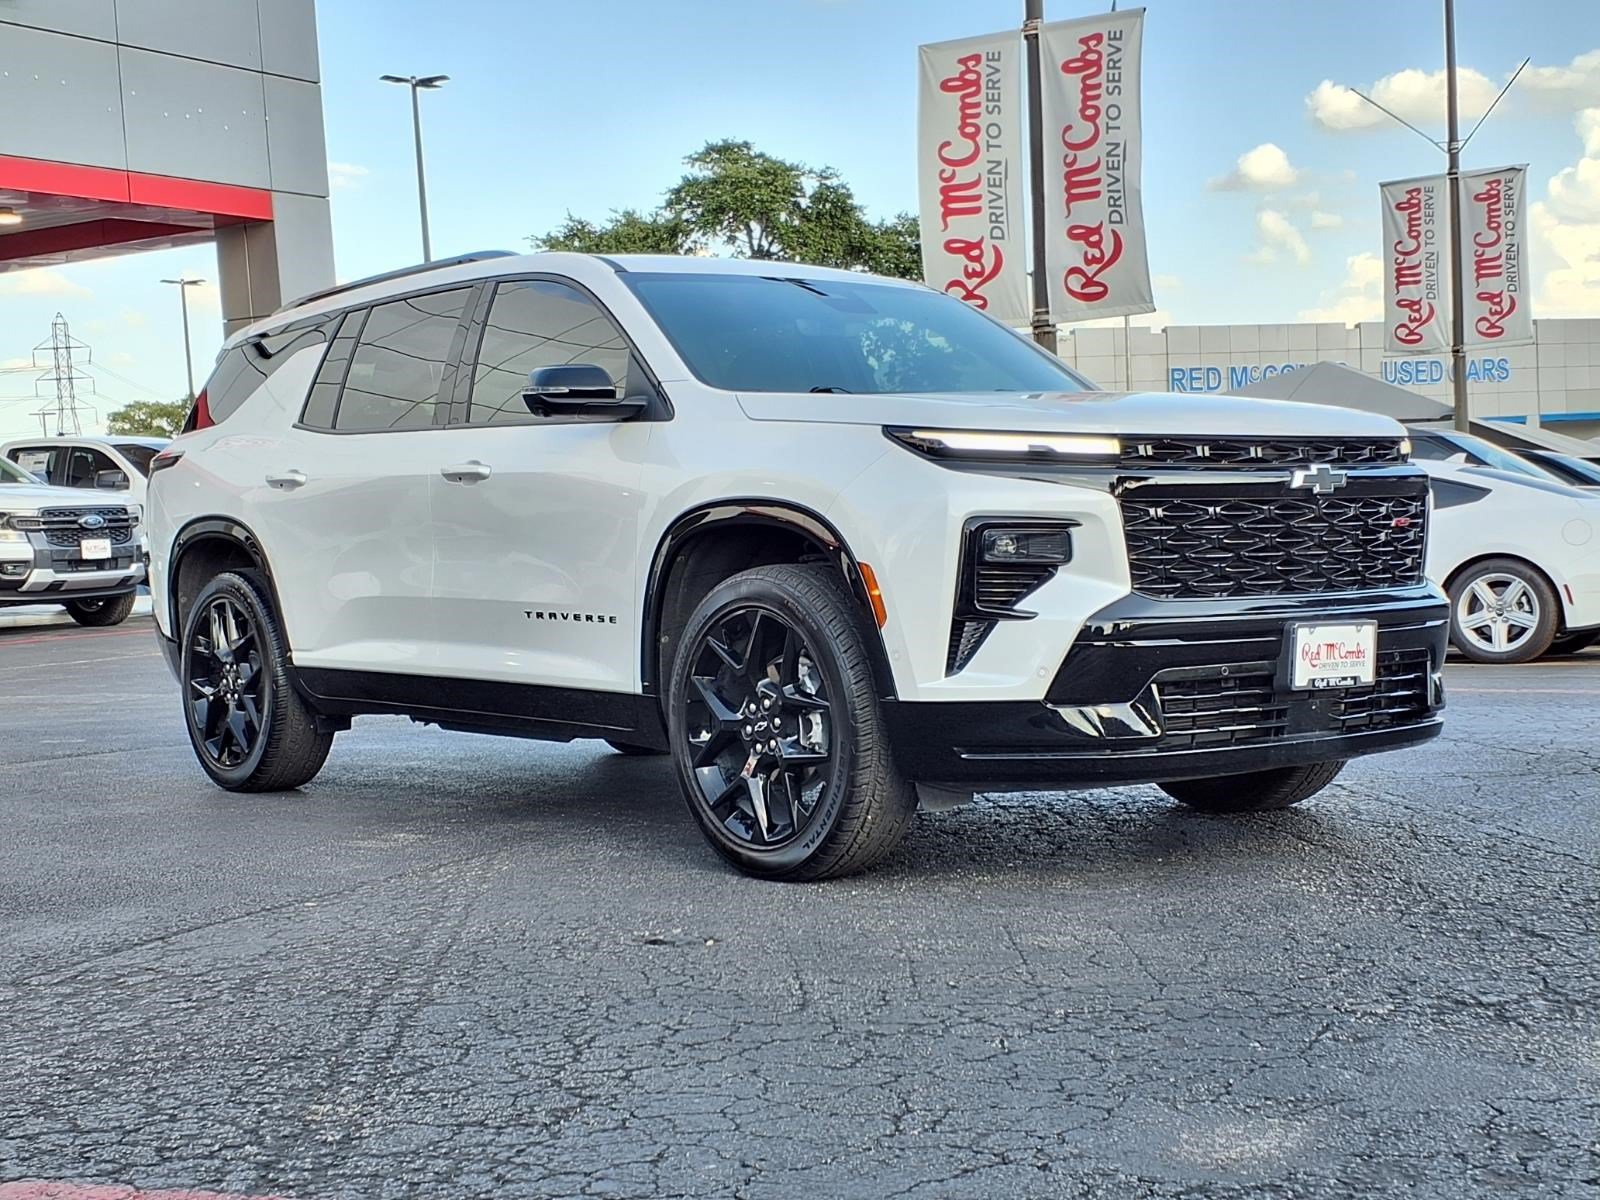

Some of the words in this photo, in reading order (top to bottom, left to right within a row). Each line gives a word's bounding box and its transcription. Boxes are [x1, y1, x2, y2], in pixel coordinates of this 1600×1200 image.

[985, 51, 1001, 115] SERVE
[1106, 30, 1123, 96] SERVE
[937, 53, 983, 232] McCombs
[986, 121, 1002, 152] TO
[1062, 33, 1104, 218] McCombs
[1106, 104, 1122, 136] TO
[986, 159, 1005, 241] DRIVEN
[1107, 143, 1124, 225] DRIVEN
[1424, 186, 1435, 225] SERVE
[1504, 178, 1514, 216] SERVE
[1394, 188, 1422, 295] McCombs
[1424, 230, 1435, 247] TO
[1473, 179, 1502, 288] McCombs
[1504, 222, 1515, 238] TO
[945, 236, 1003, 310] Red
[1064, 221, 1123, 301] Red
[1425, 252, 1436, 300] DRIVEN
[1505, 244, 1517, 293] DRIVEN
[1394, 298, 1434, 345] Red
[1475, 291, 1516, 338] Red
[1170, 367, 1222, 392] RED
[1383, 359, 1443, 384] USED
[524, 611, 617, 624] TRAVERSE
[1301, 642, 1321, 668] Red
